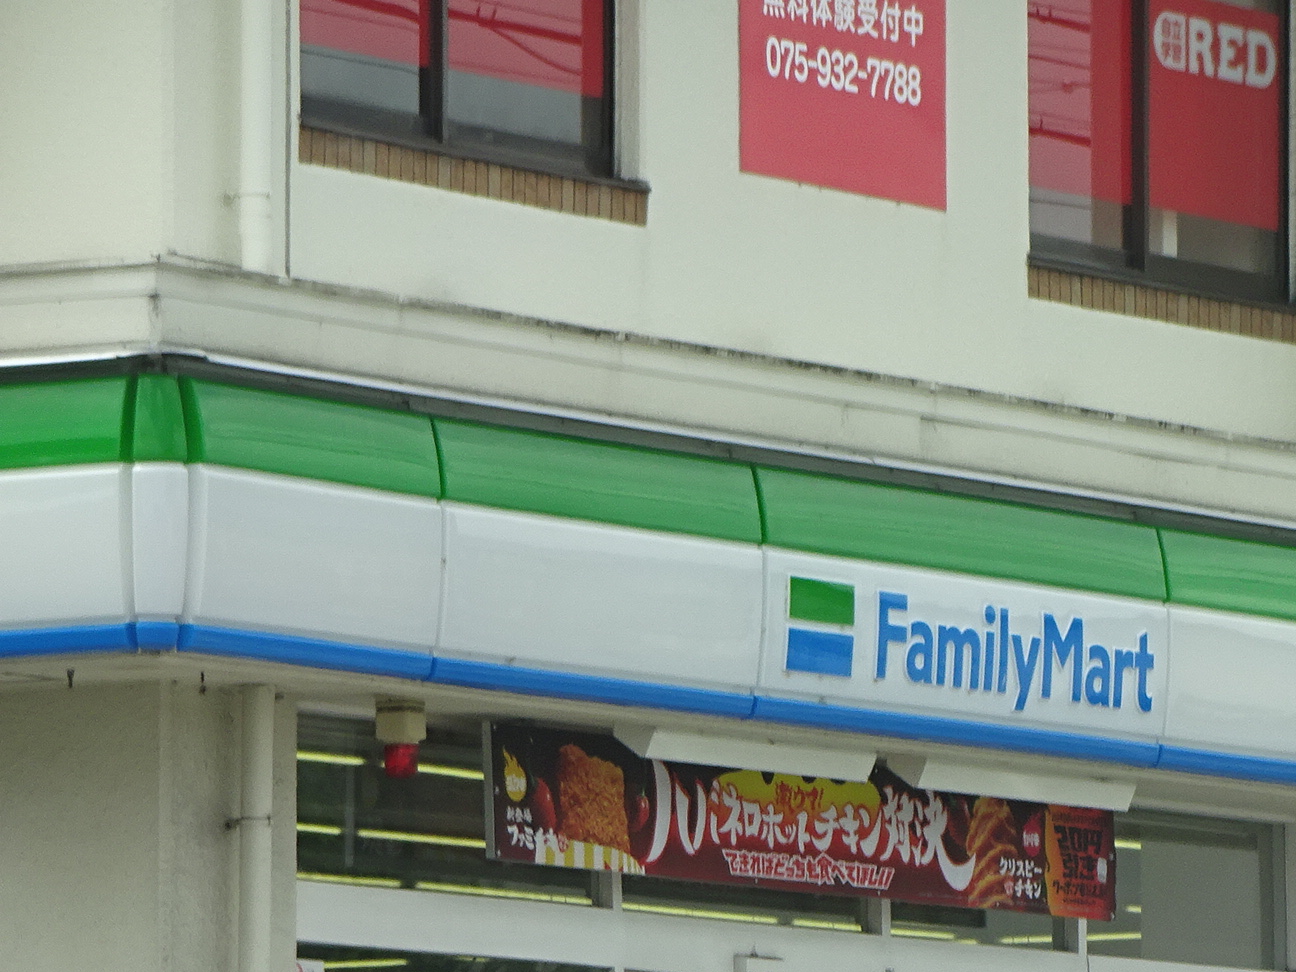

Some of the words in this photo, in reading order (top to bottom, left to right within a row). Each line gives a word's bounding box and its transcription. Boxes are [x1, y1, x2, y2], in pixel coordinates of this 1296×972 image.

[765, 35, 923, 106] 075-932-7788
[1188, 16, 1277, 89] RED
[875, 590, 1154, 714] FamilyMart
[1014, 878, 1042, 899] チキン
